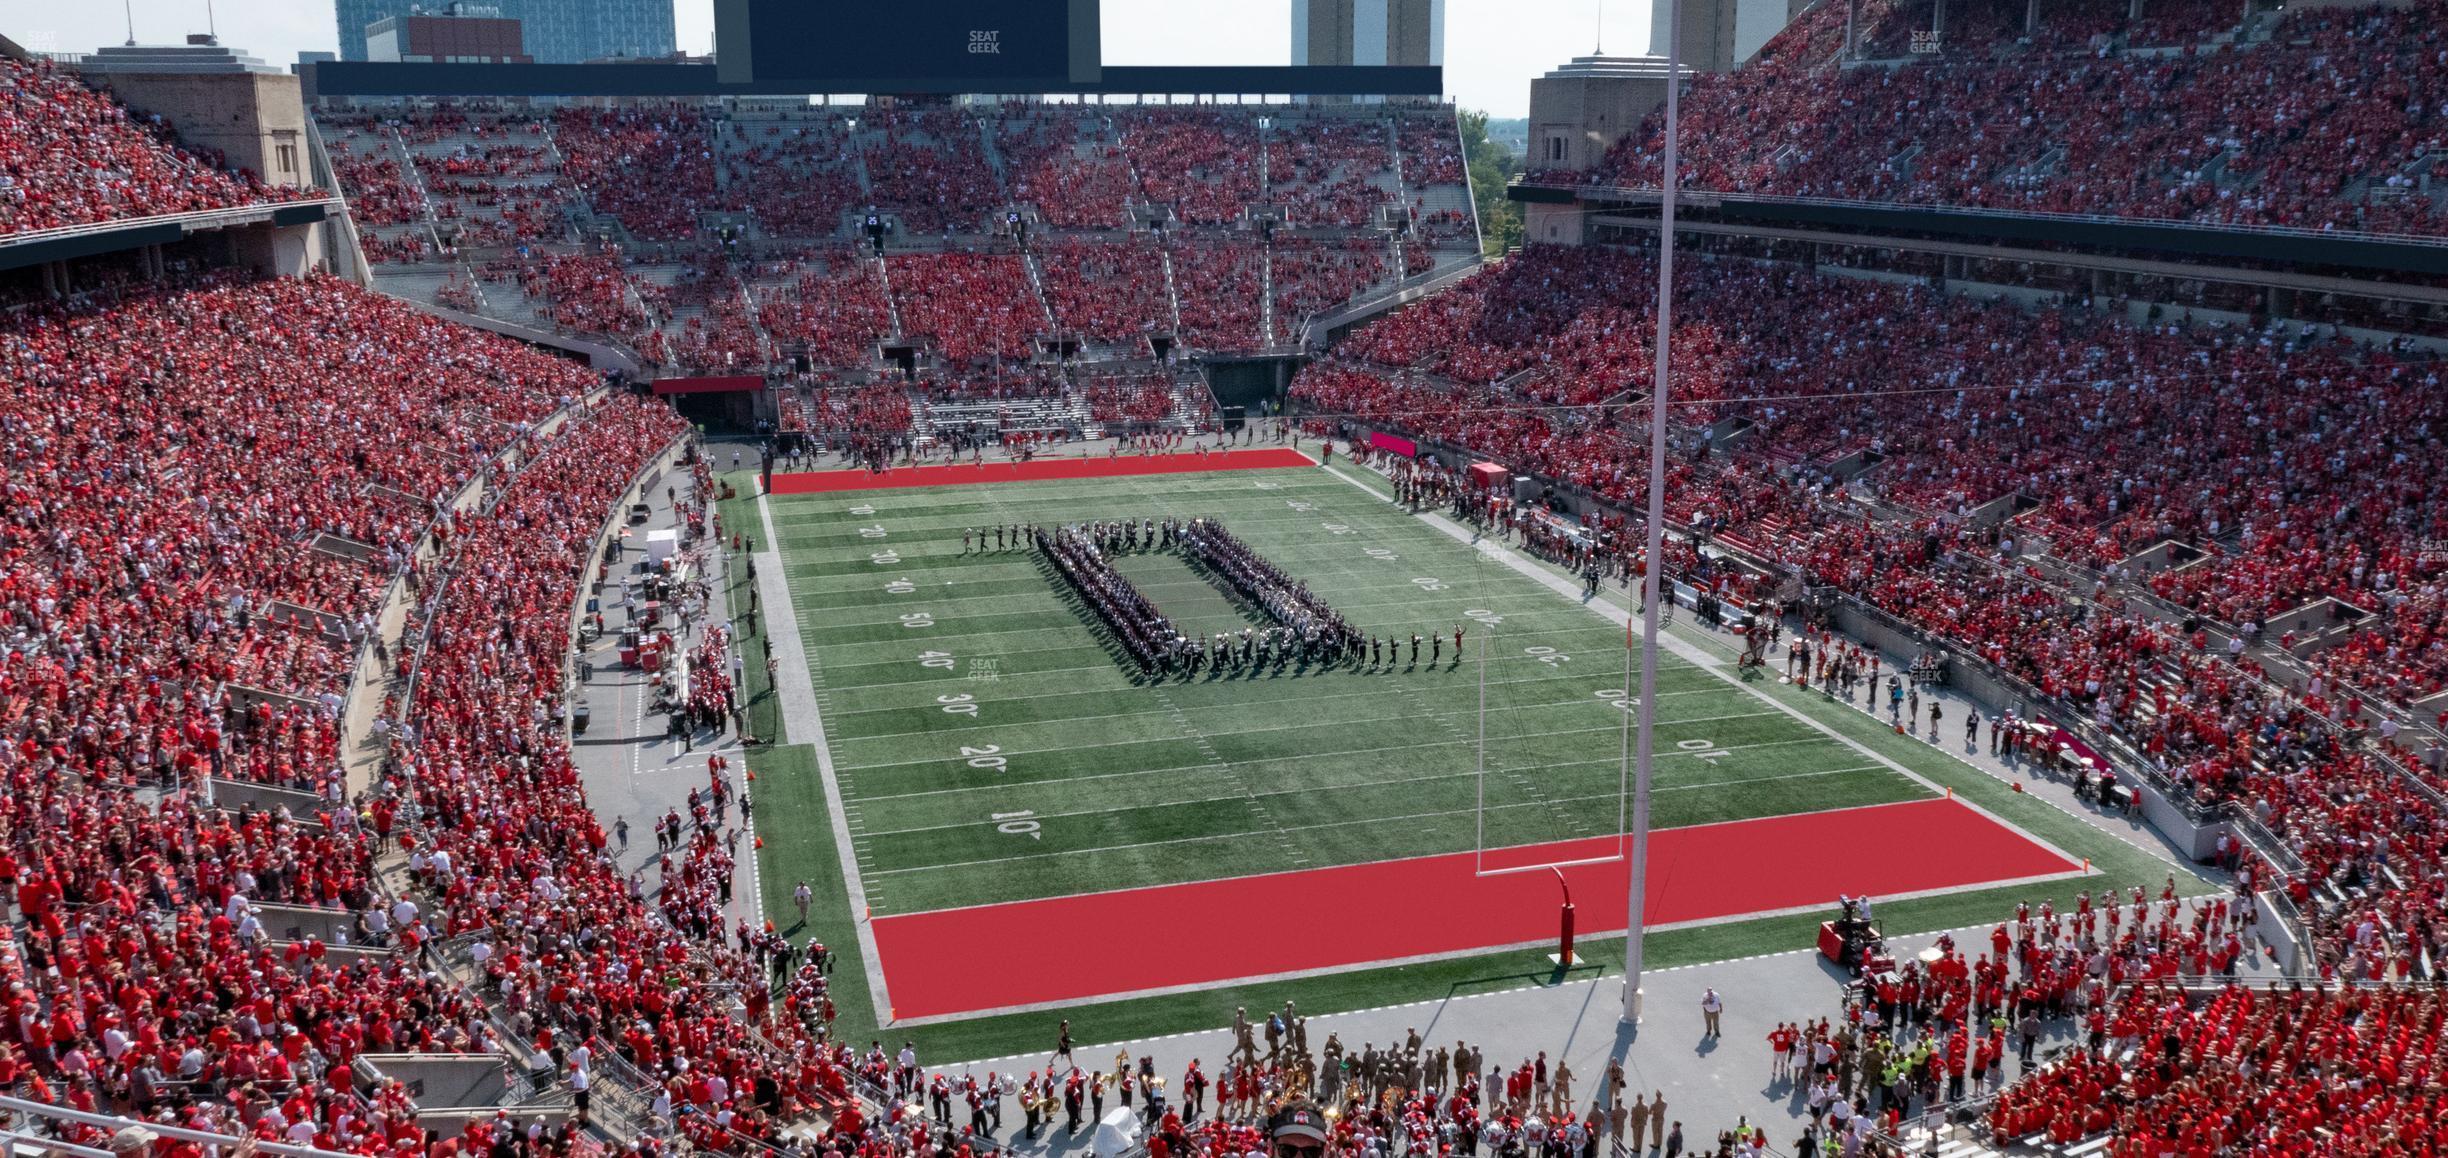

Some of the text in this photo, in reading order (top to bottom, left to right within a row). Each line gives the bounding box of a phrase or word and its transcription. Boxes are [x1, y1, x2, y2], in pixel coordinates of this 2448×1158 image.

[859, 527, 887, 537] 20
[871, 551, 900, 564] 30
[1366, 549, 1399, 560] 40
[885, 580, 916, 593] 40
[1412, 577, 1449, 591] 50
[899, 612, 934, 627] 50
[1464, 609, 1504, 623] 40
[918, 651, 954, 667] 40
[1524, 646, 1571, 662] 30
[937, 694, 978, 713] 30
[1594, 689, 1641, 708] 20
[960, 745, 1007, 767] 20
[1677, 740, 1732, 758] 10
[991, 810, 1040, 833] 10
[1528, 1129, 1544, 1142] M
